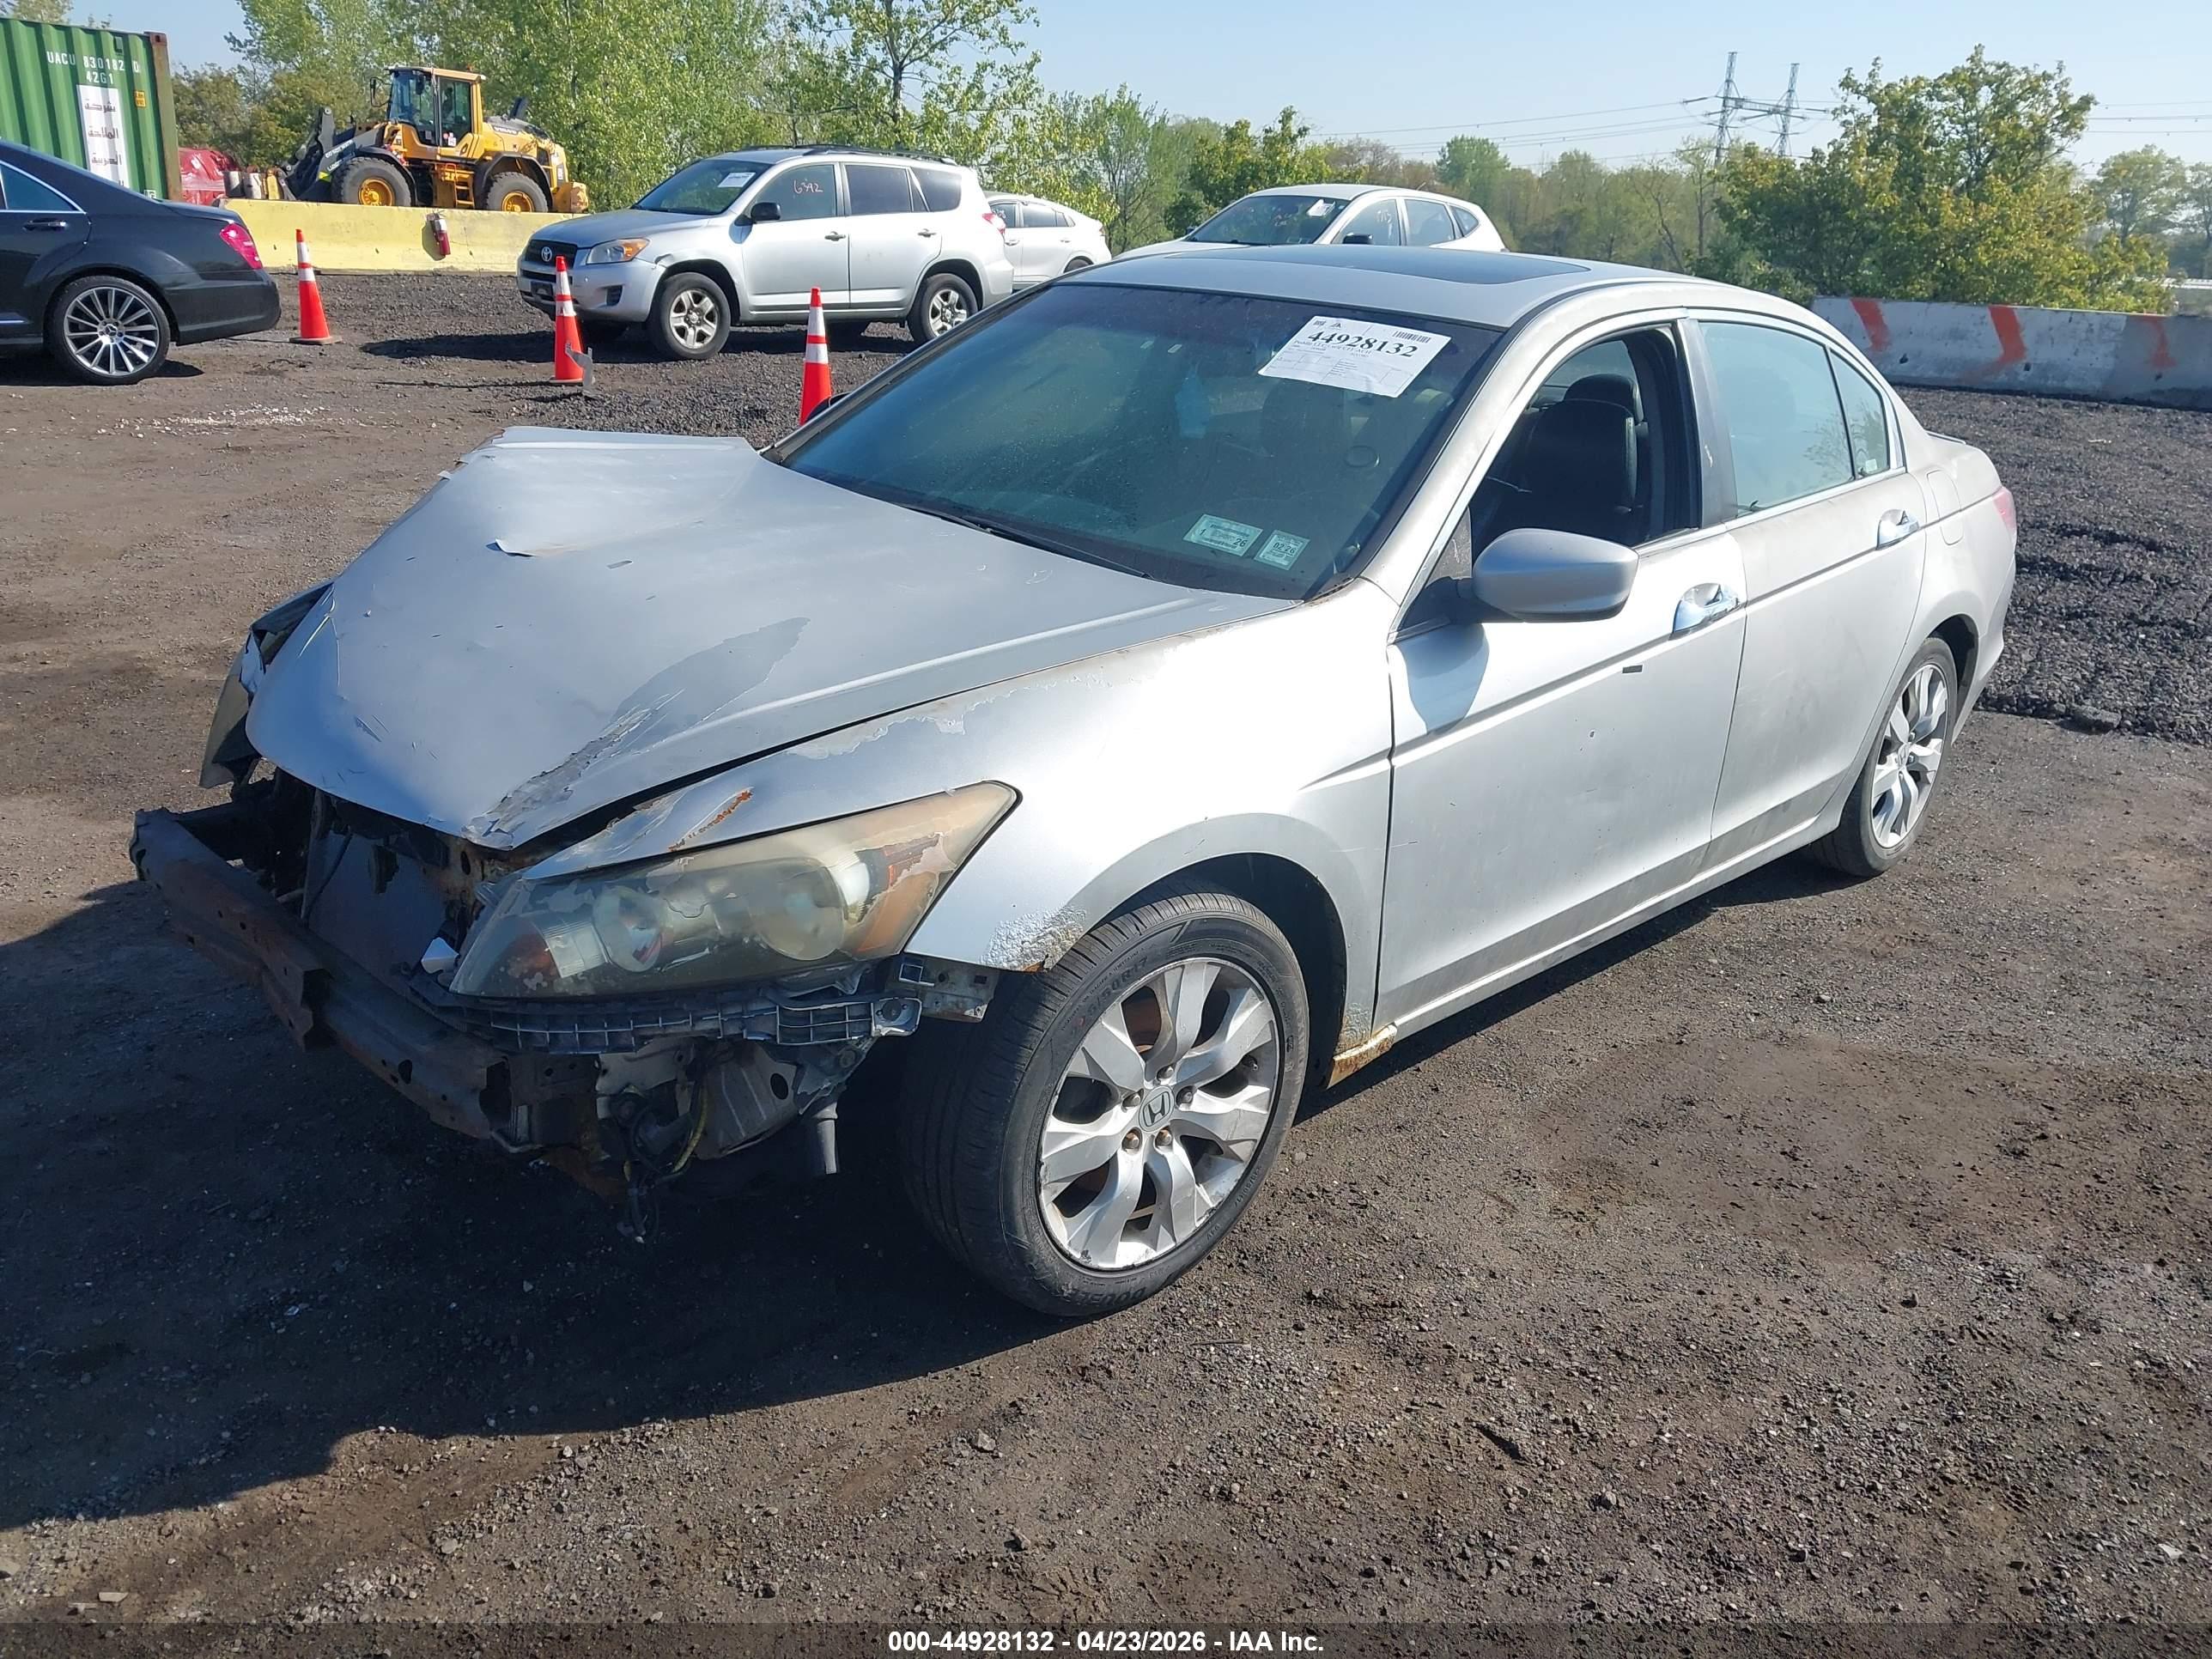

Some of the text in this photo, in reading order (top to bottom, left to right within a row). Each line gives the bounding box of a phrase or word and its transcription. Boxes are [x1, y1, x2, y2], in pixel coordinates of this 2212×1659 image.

[46, 51, 76, 65] UACU
[82, 56, 125, 71] 830182
[86, 70, 114, 84] 42G1
[1307, 330, 1419, 358] 44928132
[1233, 538, 1248, 548] 26
[1273, 542, 1296, 554] 02 26
